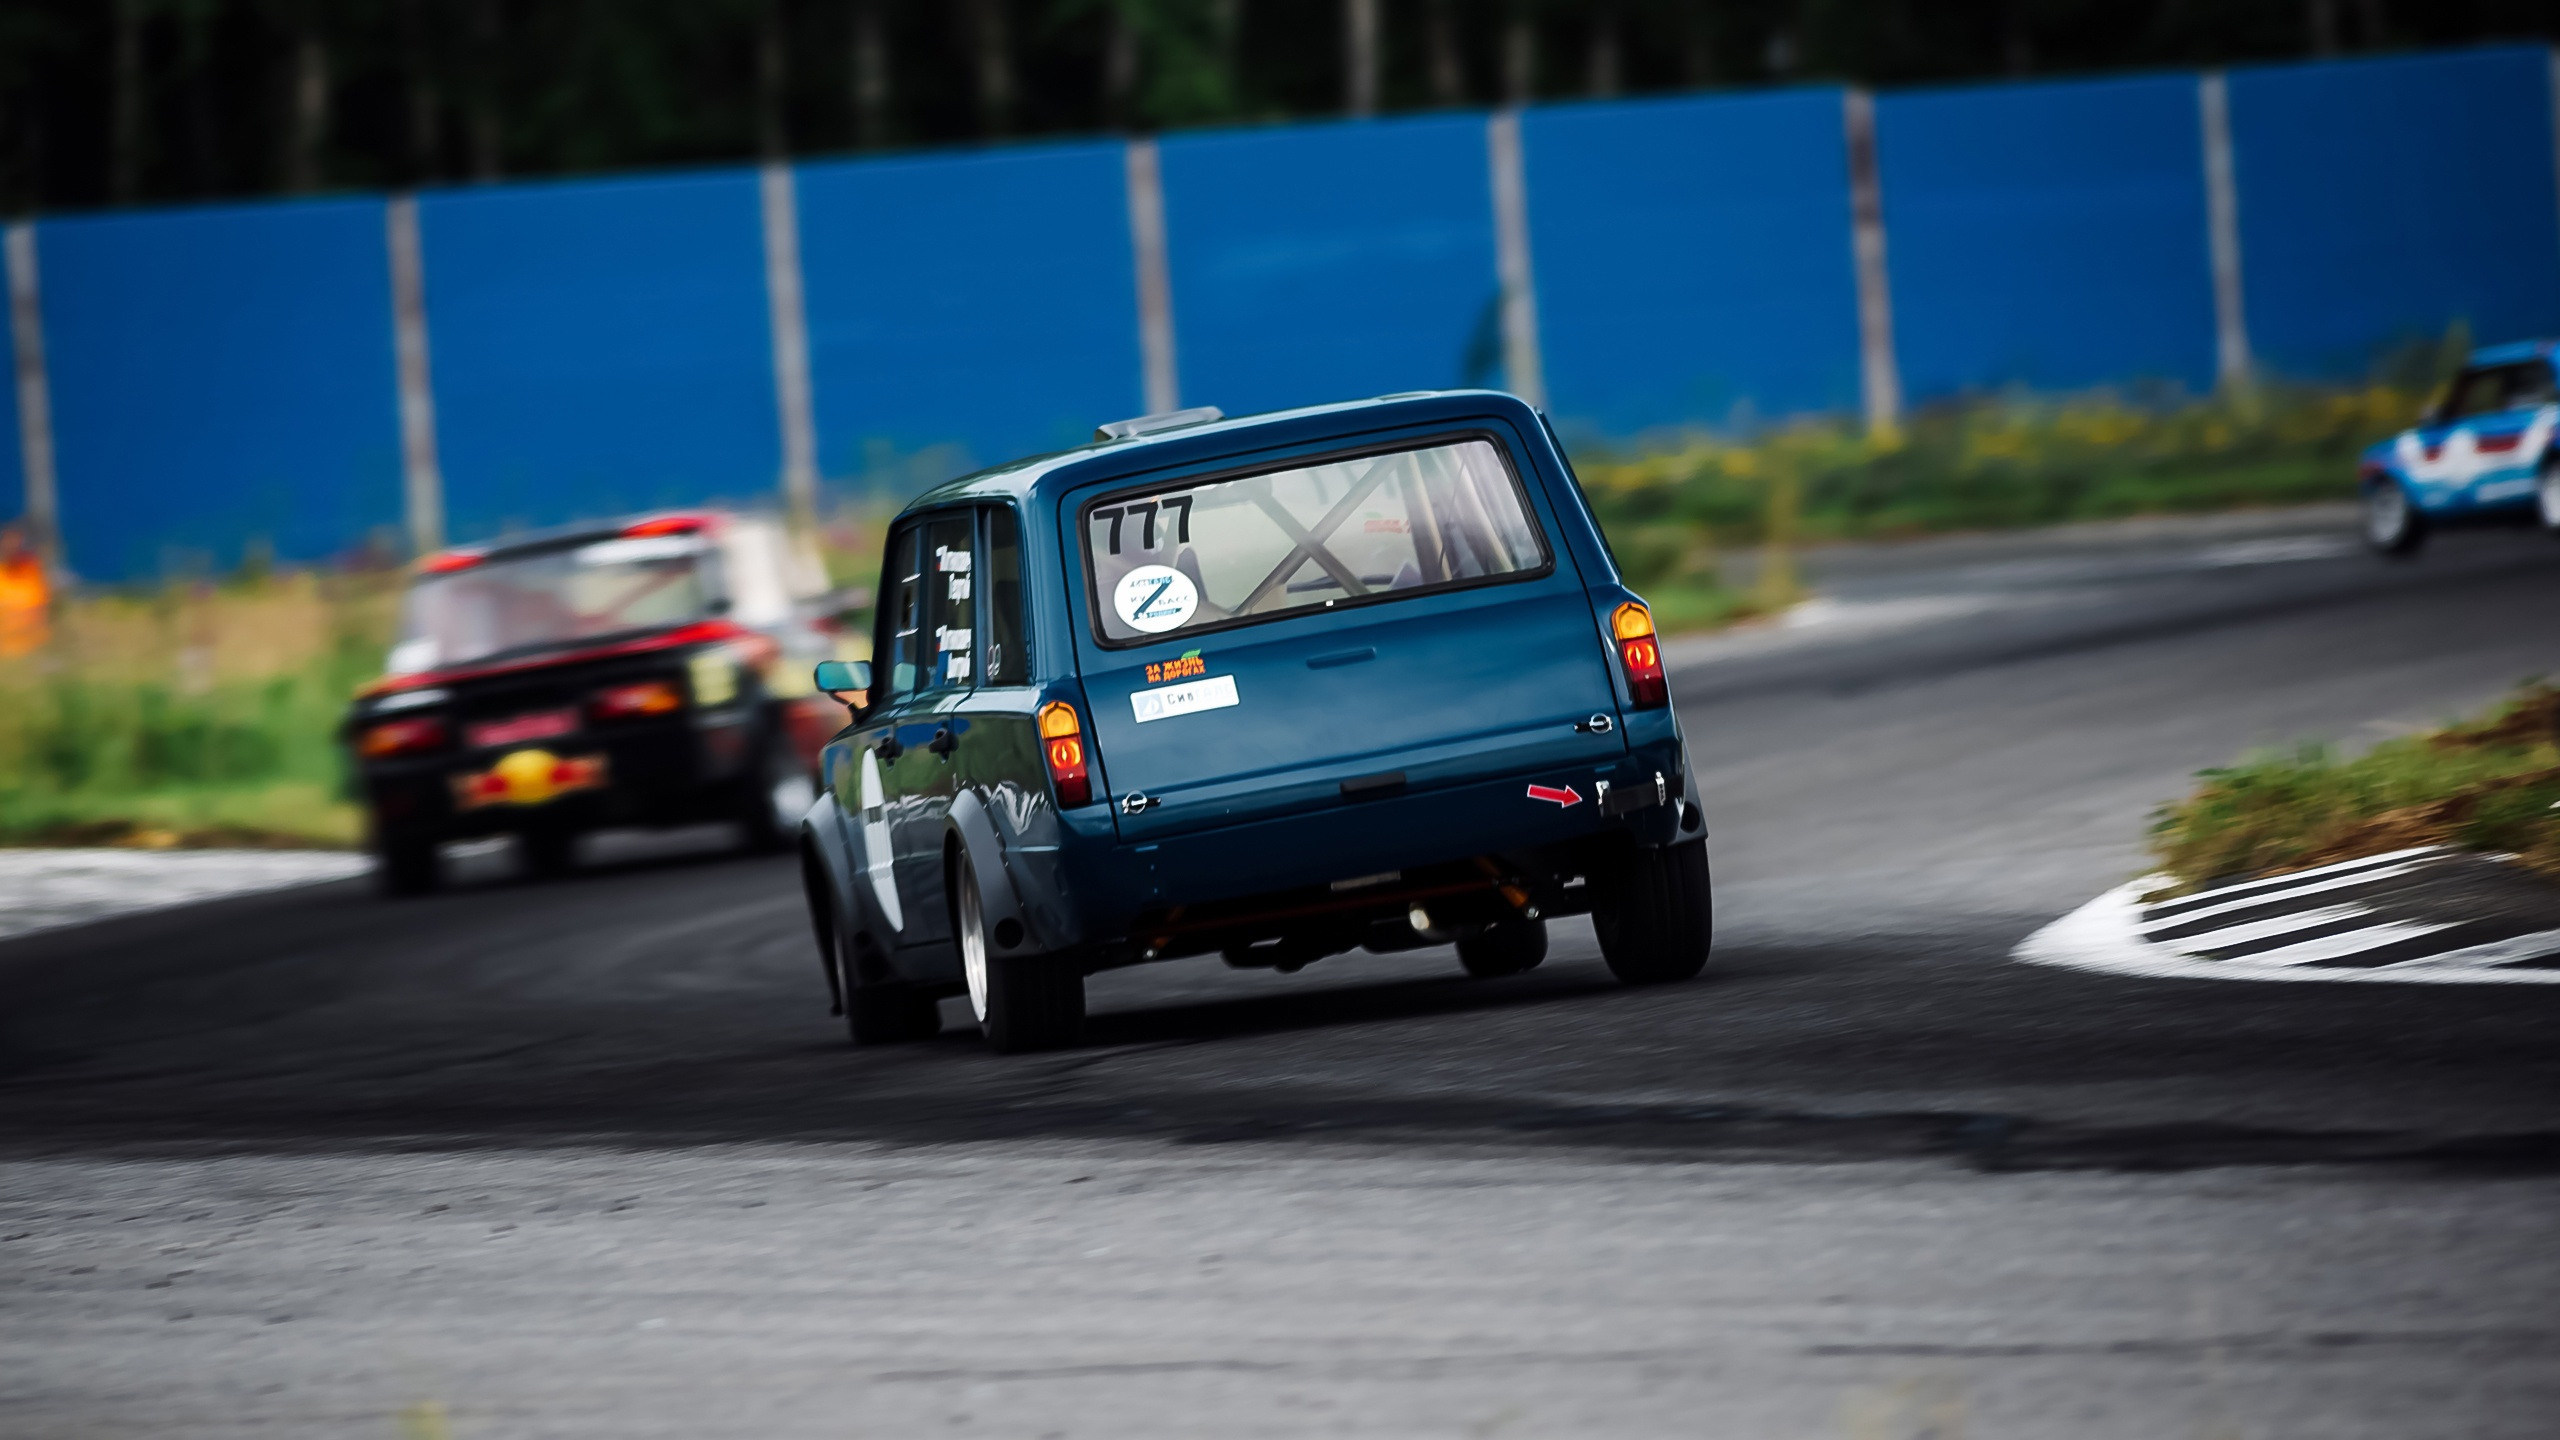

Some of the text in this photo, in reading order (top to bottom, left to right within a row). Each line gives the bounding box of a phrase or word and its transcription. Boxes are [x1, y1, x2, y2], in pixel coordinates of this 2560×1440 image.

[1093, 494, 1193, 555] 777
[1145, 656, 1204, 676] ЗА ЖИЗНЬ
